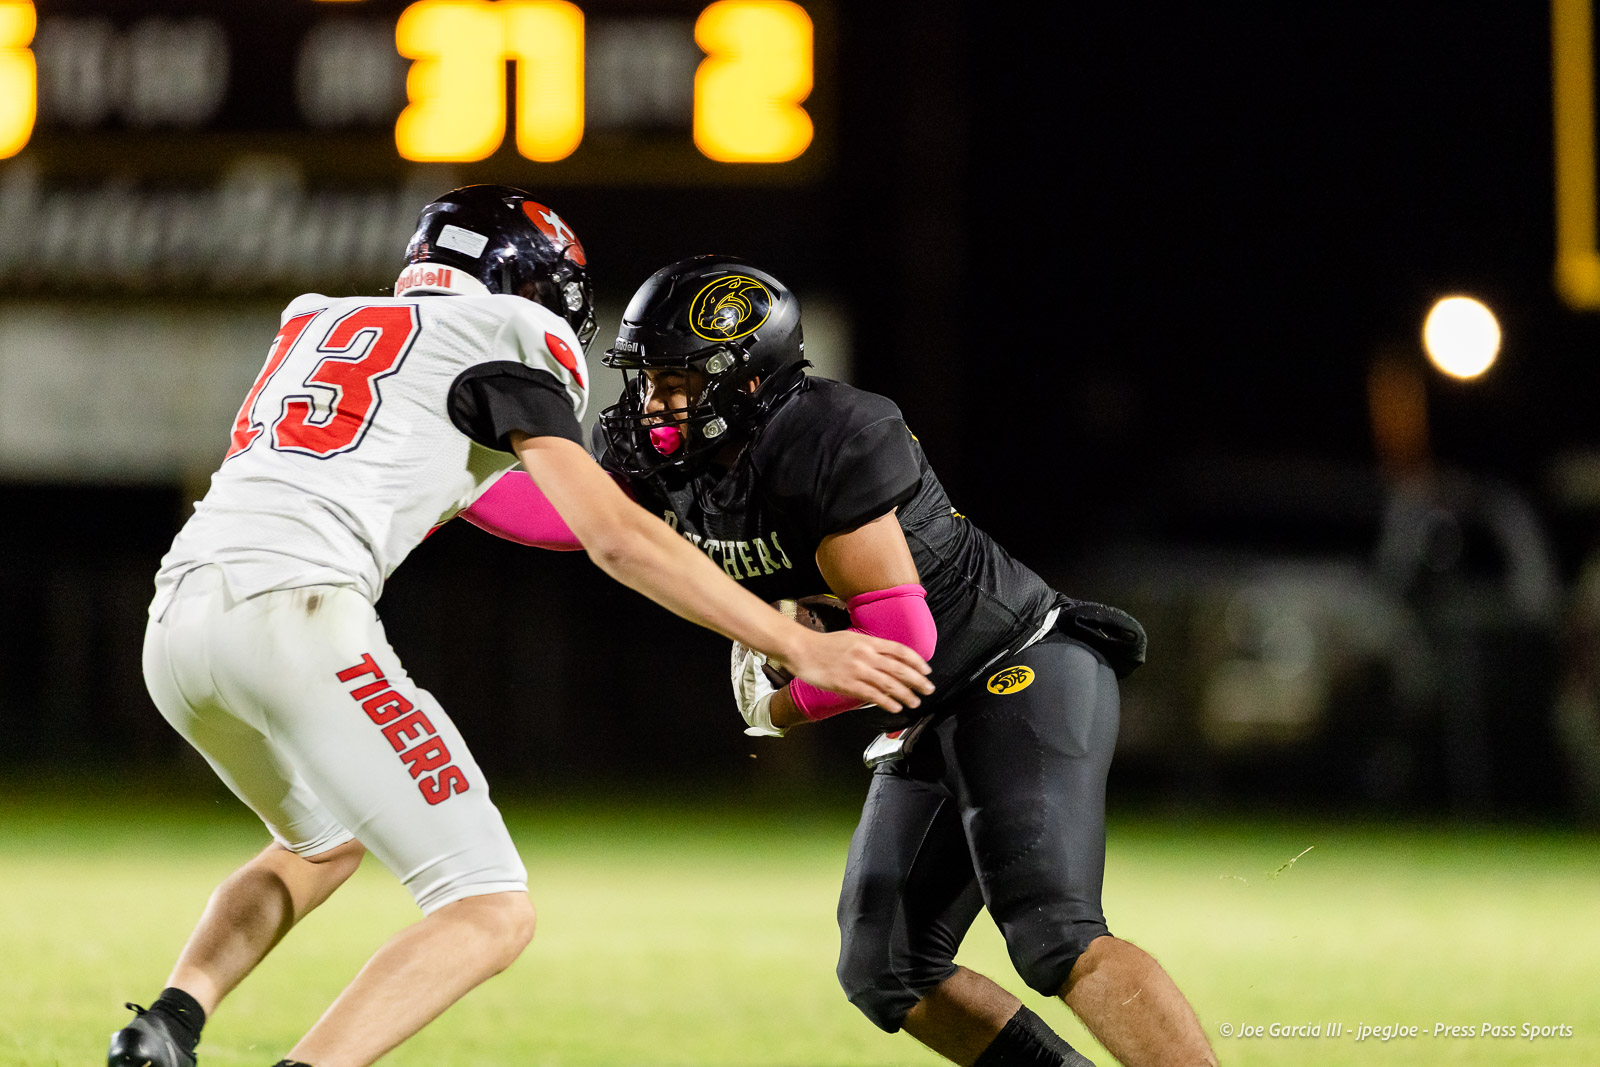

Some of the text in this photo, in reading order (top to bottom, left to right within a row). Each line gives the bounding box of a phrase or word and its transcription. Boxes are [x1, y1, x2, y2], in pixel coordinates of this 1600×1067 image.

[694, 0, 815, 163] 2
[224, 303, 422, 460] 13
[663, 509, 793, 581] PTHERS
[335, 652, 470, 806] TIGERS
